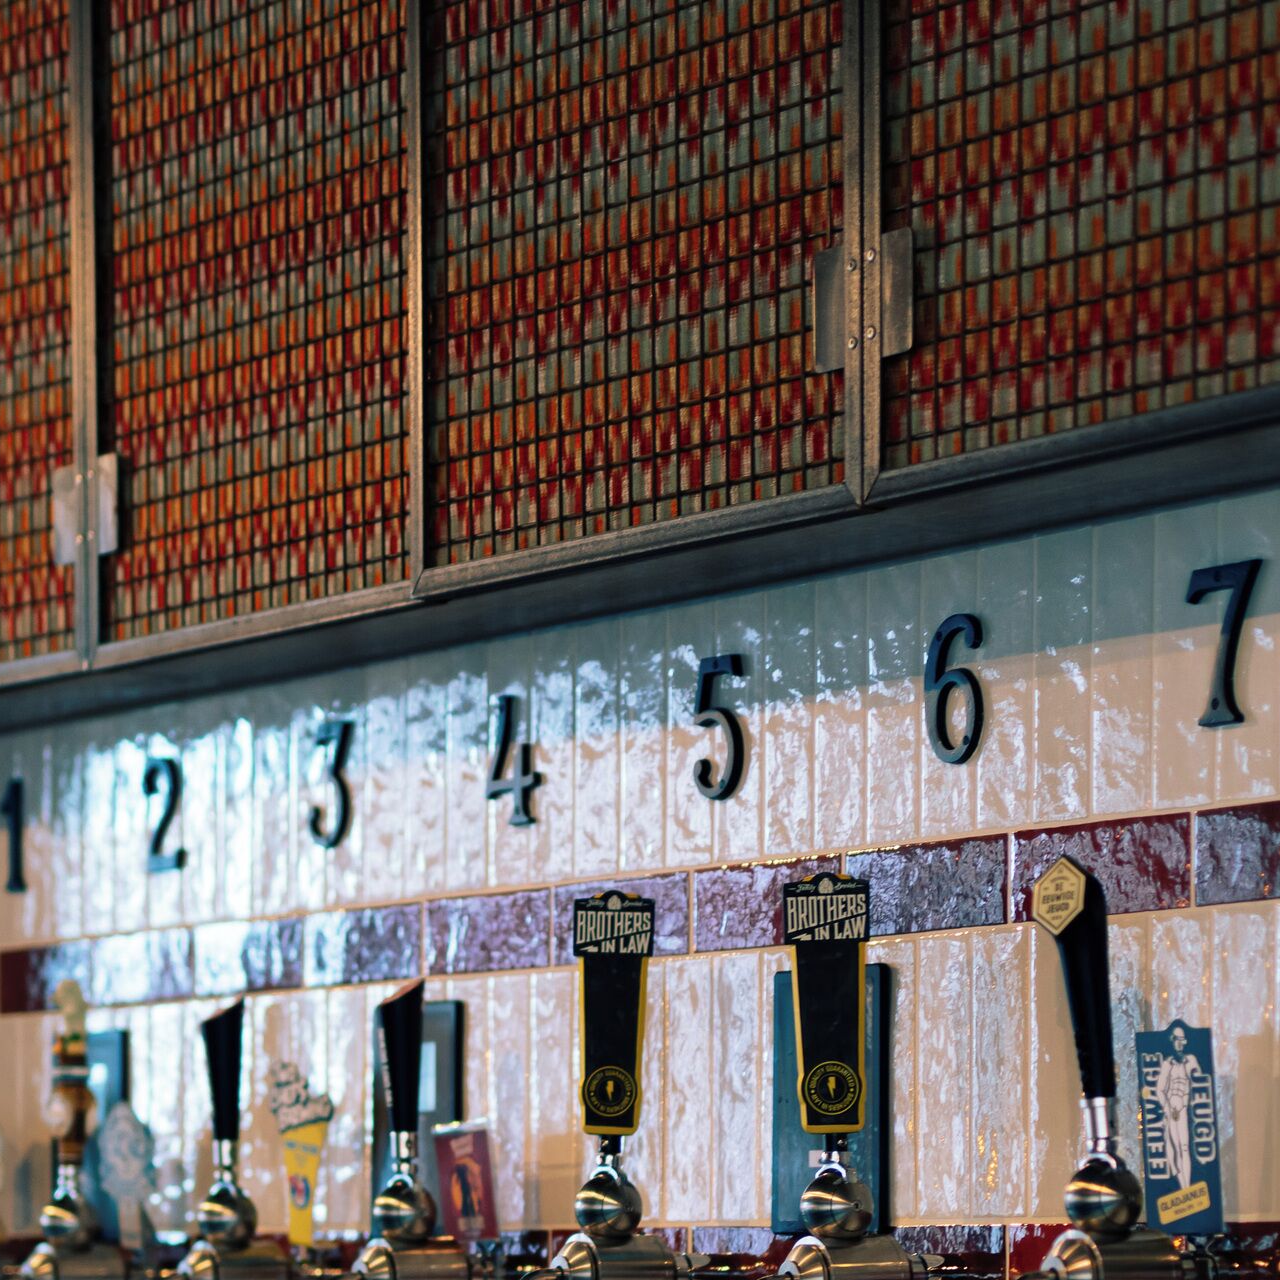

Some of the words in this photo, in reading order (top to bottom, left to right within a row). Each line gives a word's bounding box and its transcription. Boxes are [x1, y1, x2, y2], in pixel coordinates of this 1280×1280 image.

[924, 613, 984, 765] 6
[1186, 558, 1263, 728] 7
[310, 720, 354, 848] 3
[486, 695, 543, 826] 4
[693, 653, 744, 801] 5
[0, 776, 27, 893] 1
[144, 758, 187, 873] 2
[576, 911, 652, 945] BROTHERS
[601, 939, 616, 953] IN
[619, 931, 652, 954] LAW
[786, 894, 867, 934] BROTHERS
[815, 924, 830, 940] IN
[834, 914, 867, 940] LAW
[1189, 1067, 1217, 1164] JEUGD
